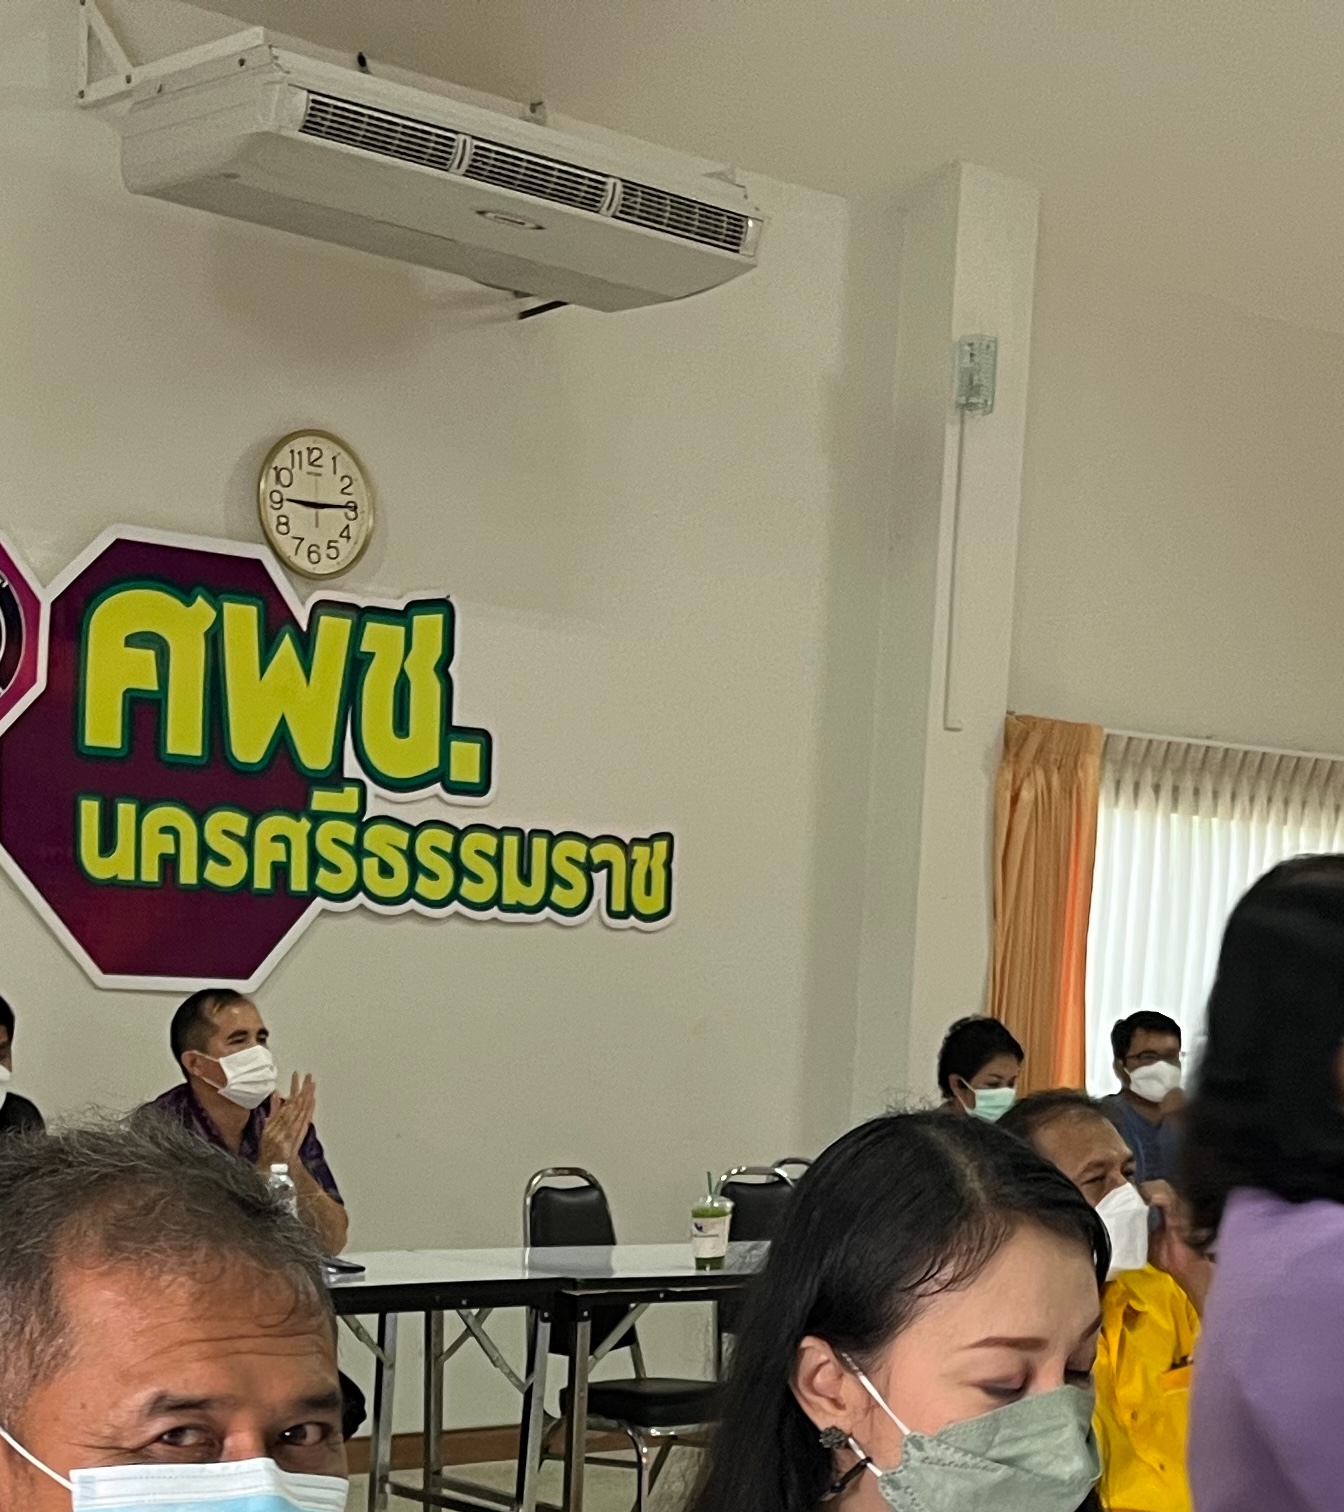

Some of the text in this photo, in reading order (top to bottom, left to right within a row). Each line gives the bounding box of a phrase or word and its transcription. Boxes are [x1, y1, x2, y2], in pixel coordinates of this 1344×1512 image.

[289, 449, 303, 471] 11
[306, 446, 324, 468] 12
[331, 455, 337, 475] 1
[272, 465, 294, 488] 10
[340, 475, 353, 496] 2
[269, 489, 284, 510] 9
[344, 500, 359, 521] 3
[275, 514, 290, 535] 8
[339, 524, 352, 543] 4
[291, 536, 305, 556] 7
[307, 543, 321, 564] 6
[326, 540, 340, 560] 5
[82, 586, 486, 786] ศพช.
[79, 785, 670, 917] นครศรีธรรมราช
